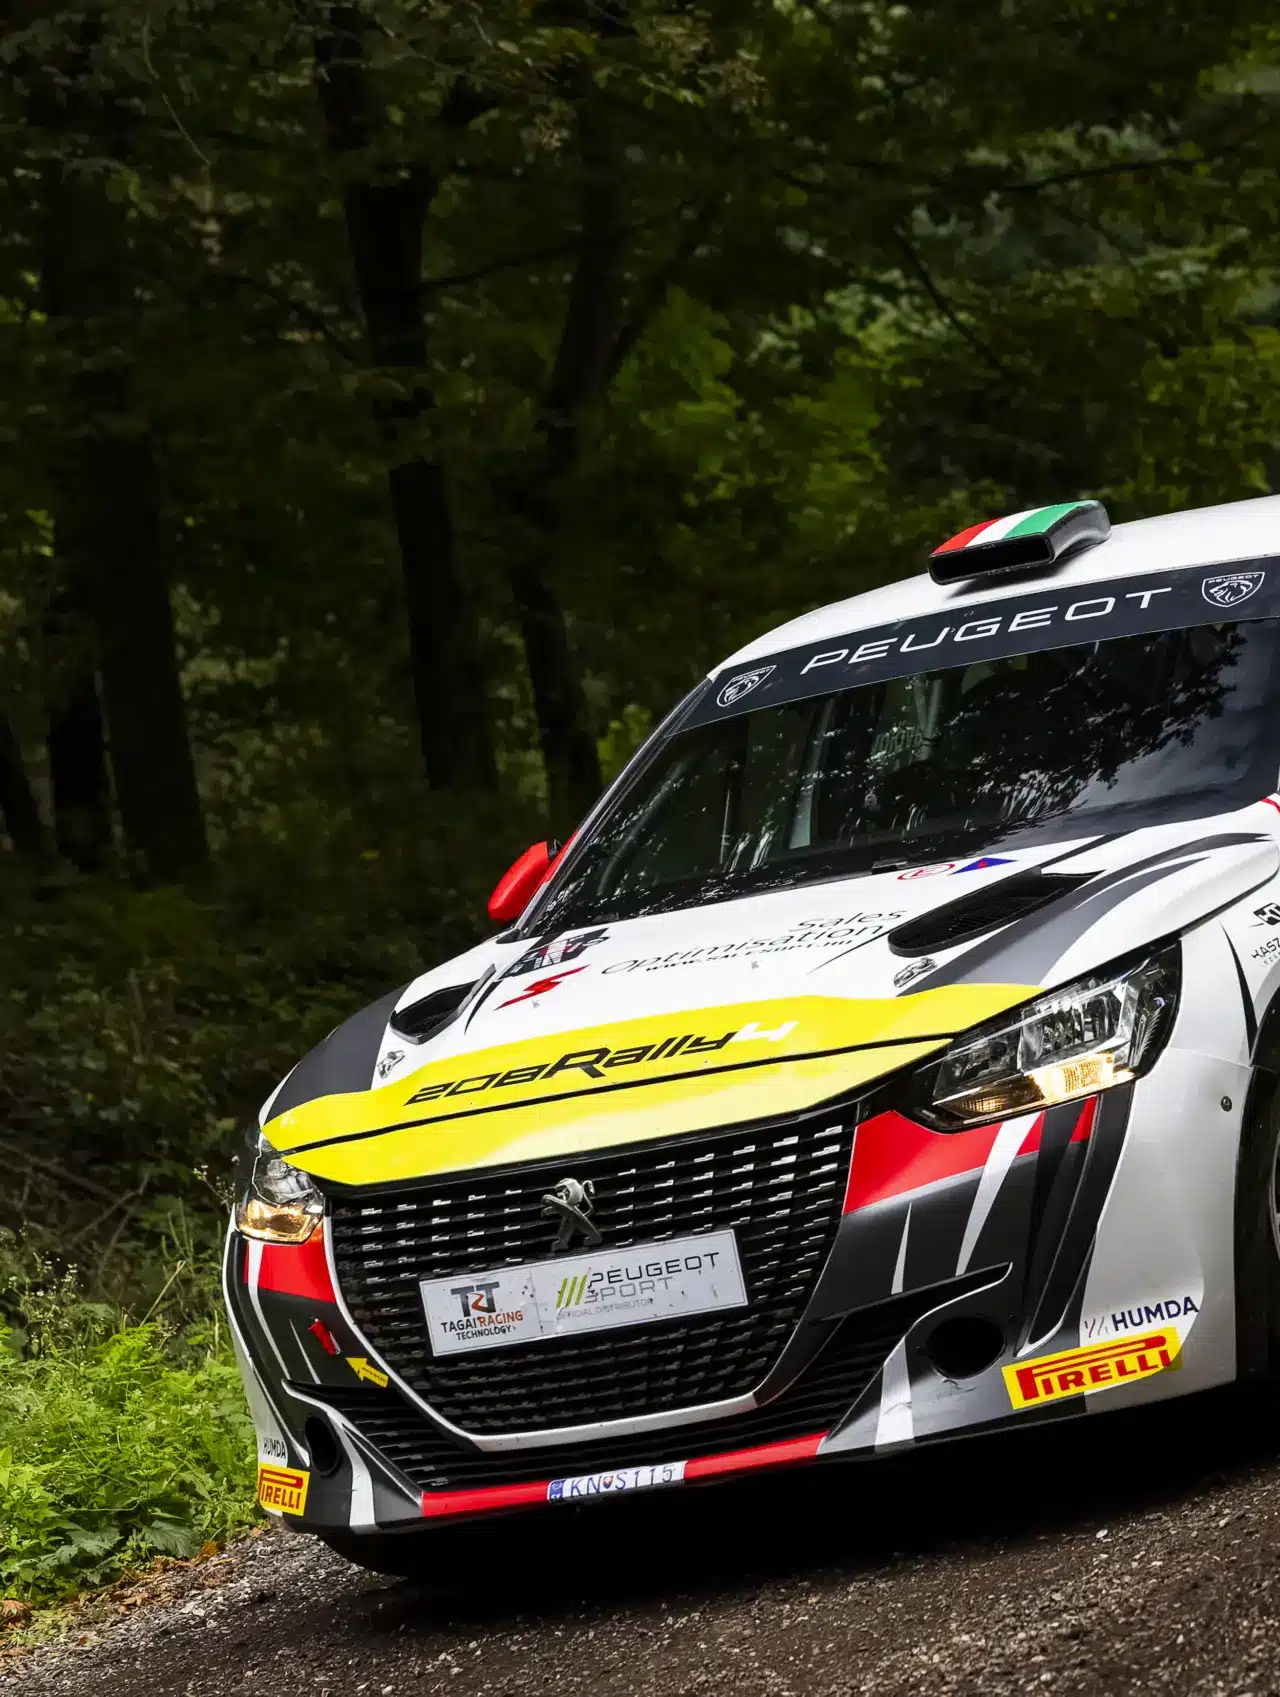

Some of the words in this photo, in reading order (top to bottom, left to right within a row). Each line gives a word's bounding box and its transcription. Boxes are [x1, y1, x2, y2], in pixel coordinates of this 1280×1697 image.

[800, 588, 1172, 675] PEUGEOT
[587, 1252, 719, 1290] PEUGEOT
[441, 1316, 478, 1335] TAGAI
[477, 1310, 523, 1328] RACING
[1111, 1296, 1199, 1332] HUMDA
[456, 1323, 517, 1342] TECHNOLOGY
[1016, 1335, 1171, 1401] PIRELLI
[263, 1437, 287, 1460] HUMDA
[259, 1468, 304, 1510] PIRELLI
[570, 1476, 601, 1498] KN
